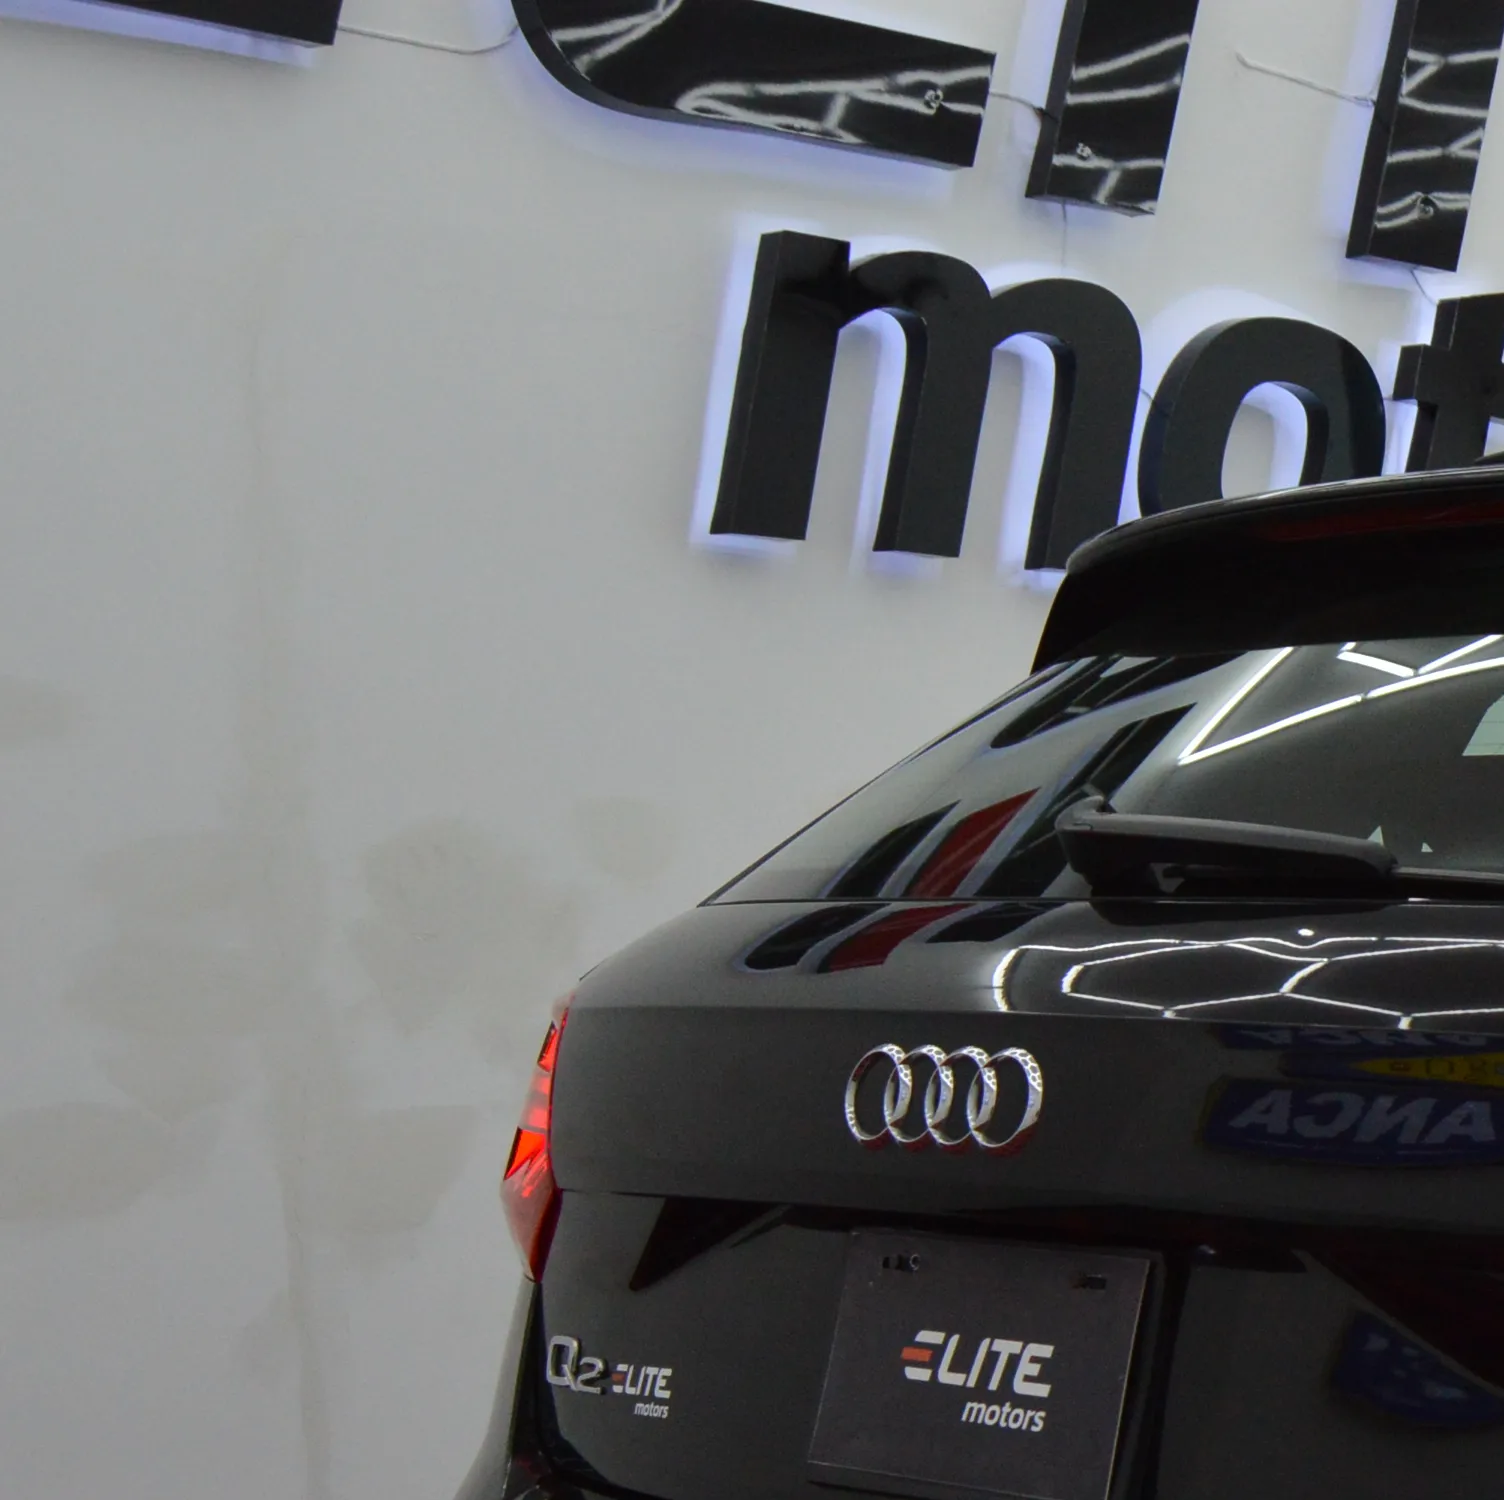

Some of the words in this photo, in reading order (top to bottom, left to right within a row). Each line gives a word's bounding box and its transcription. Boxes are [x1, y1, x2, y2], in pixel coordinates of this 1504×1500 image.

[546, 1335, 604, 1394] Q2
[611, 1363, 672, 1399] ELITE
[901, 1330, 1055, 1398] ELITE
[634, 1402, 669, 1418] motors
[961, 1400, 1047, 1432] motors
